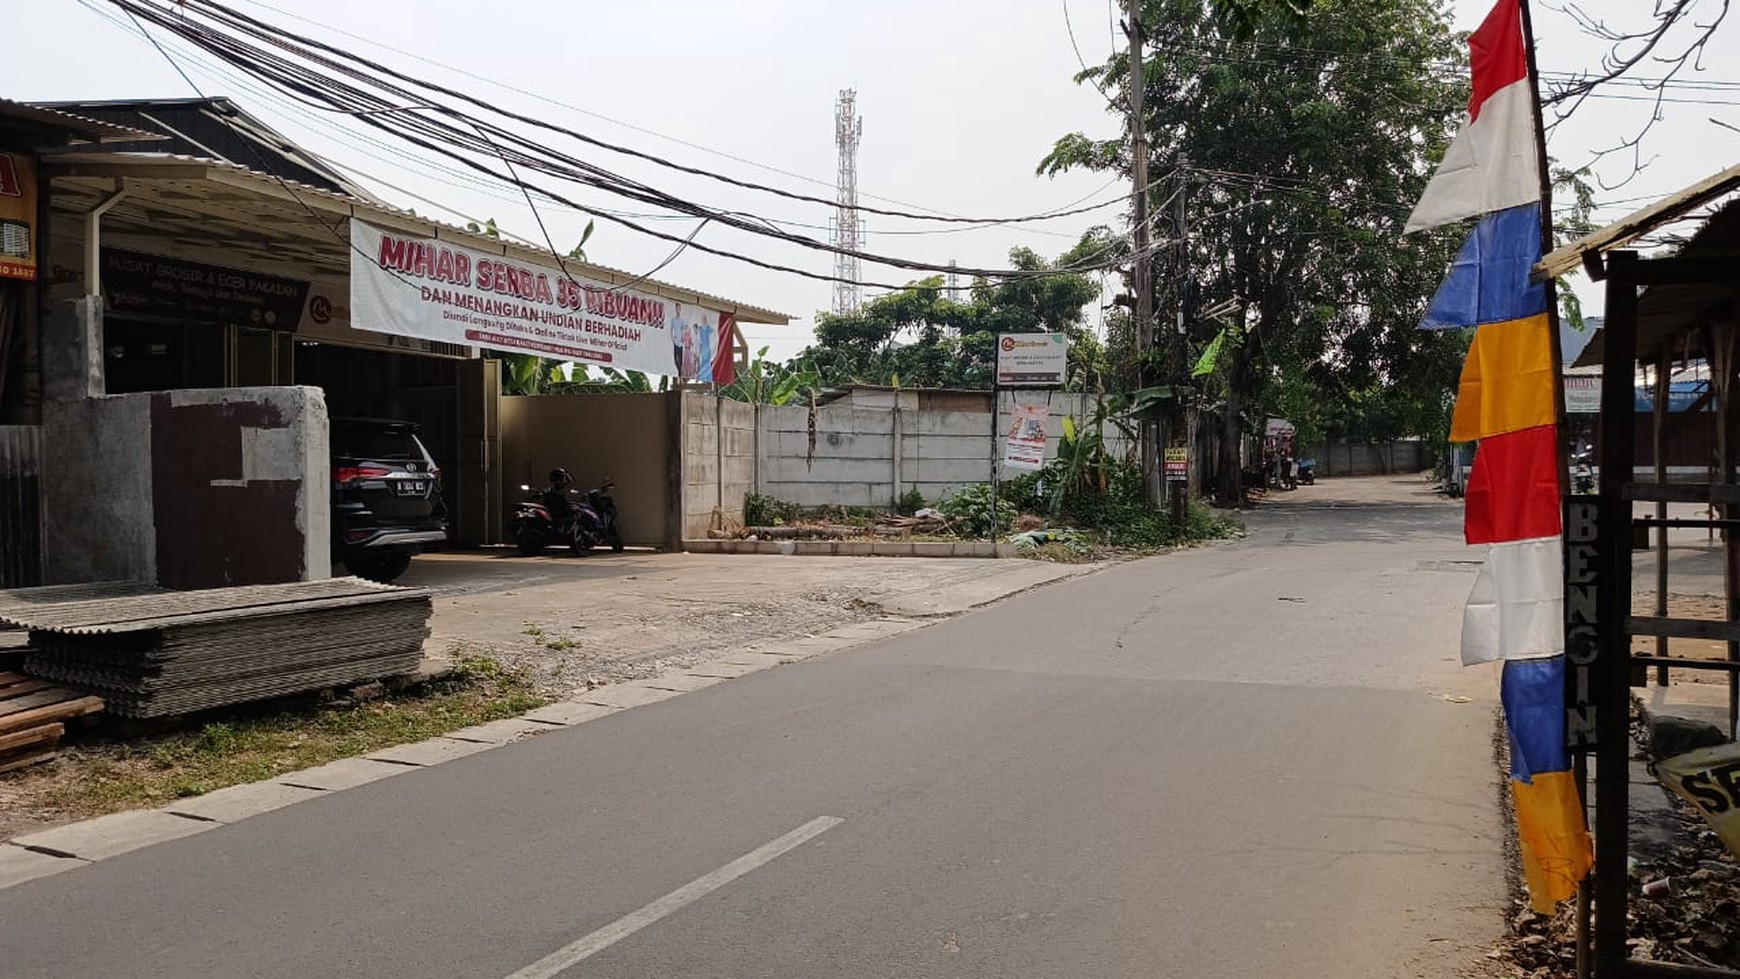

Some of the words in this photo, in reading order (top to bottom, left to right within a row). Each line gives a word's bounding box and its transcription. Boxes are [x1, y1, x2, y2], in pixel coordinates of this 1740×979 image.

[218, 273, 246, 290] ECER
[379, 235, 471, 287] MIHAR
[555, 275, 581, 310] 35
[421, 286, 452, 304] DAN
[455, 292, 539, 322] MENANGKAN
[541, 311, 583, 332] UNDIAN
[585, 320, 641, 342] BERHADIAH
[1567, 503, 1598, 747] BENSIN
